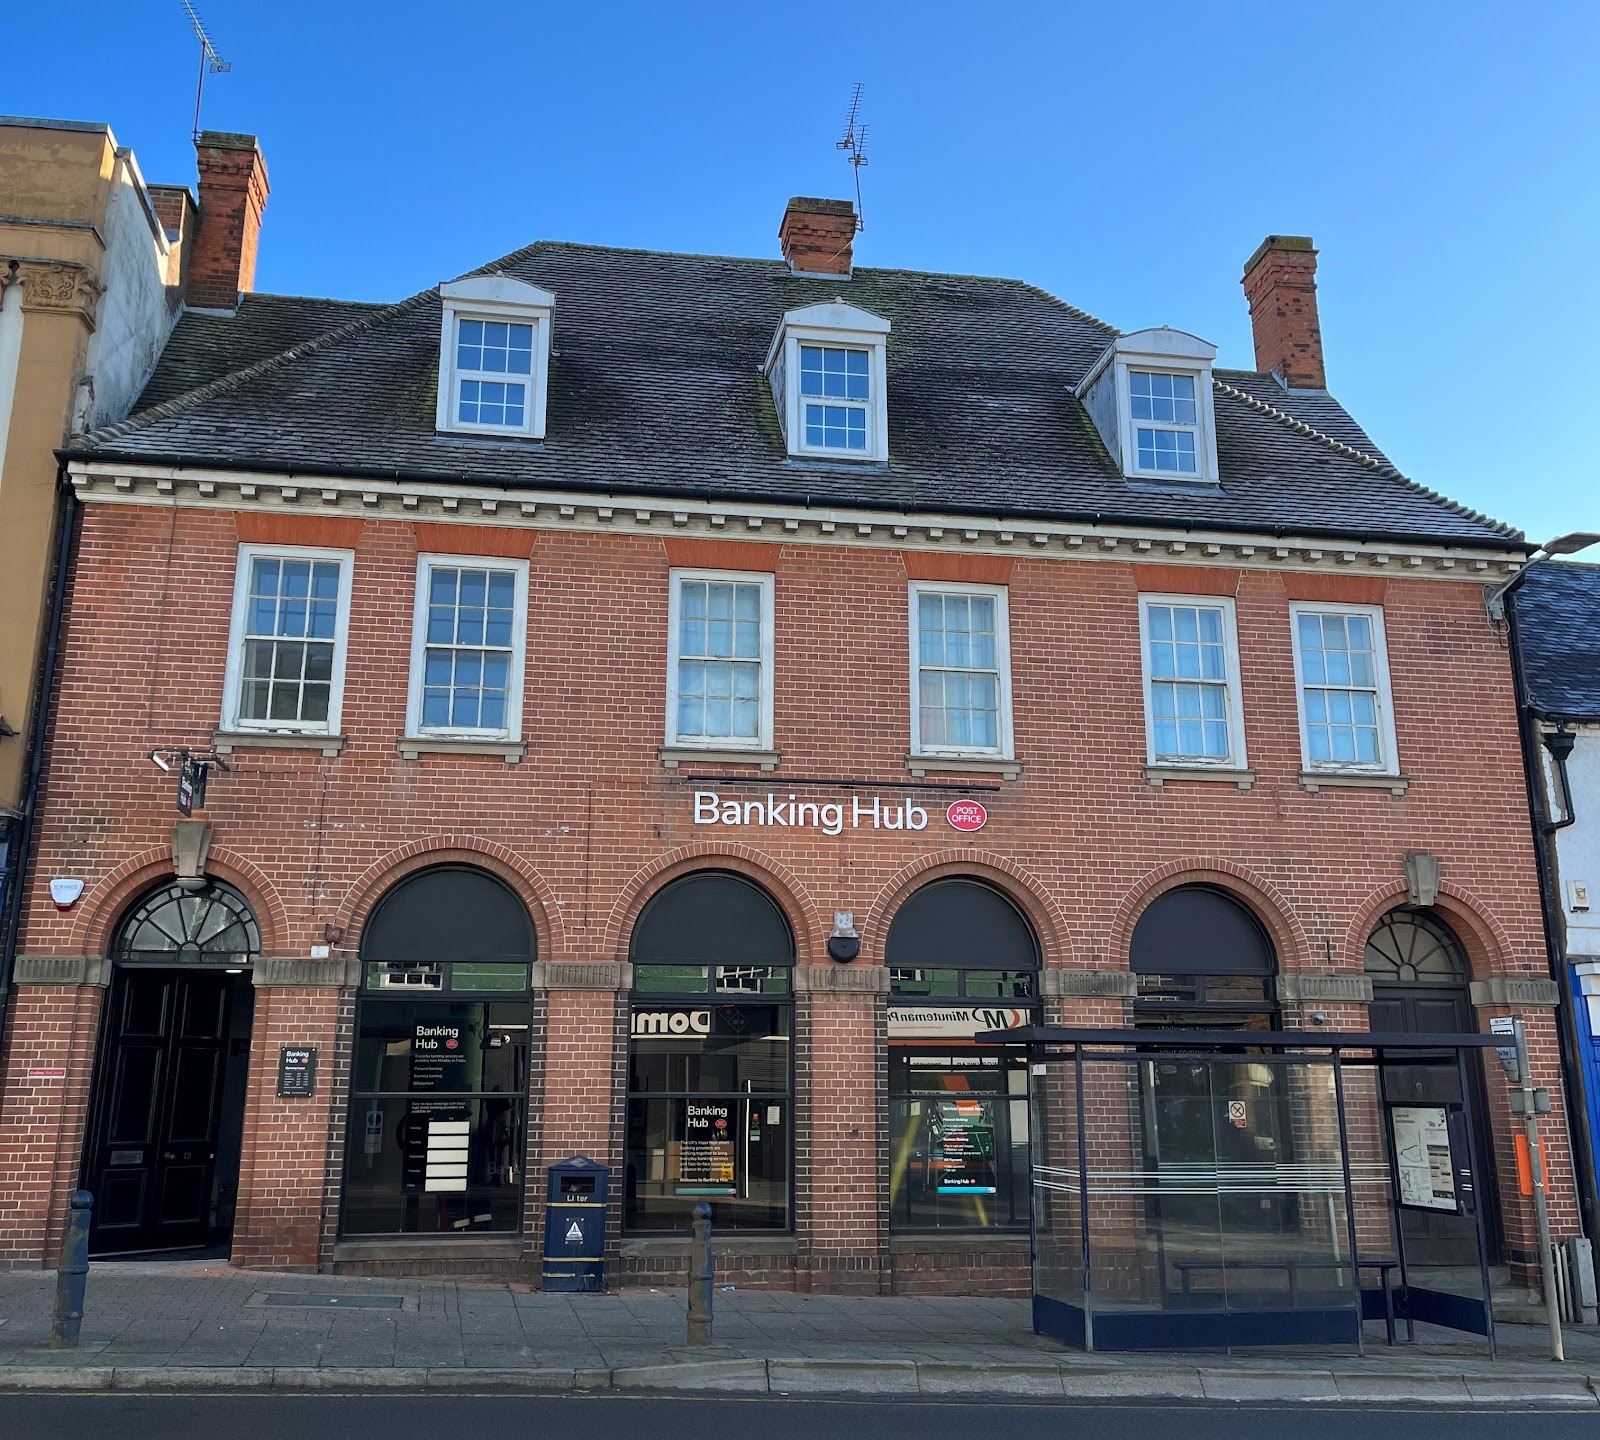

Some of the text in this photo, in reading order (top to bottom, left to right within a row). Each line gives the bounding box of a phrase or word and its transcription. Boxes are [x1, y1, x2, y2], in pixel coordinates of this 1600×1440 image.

[694, 791, 928, 836] Banking Hub
[956, 806, 979, 815] POST
[951, 815, 982, 824] OFFICE
[416, 1025, 459, 1039] Banking
[415, 1038, 438, 1049] Hub
[286, 1050, 309, 1058] Banking
[687, 1105, 728, 1118] Banking
[687, 1118, 709, 1128] Hub
[566, 1194, 589, 1203] Liter
